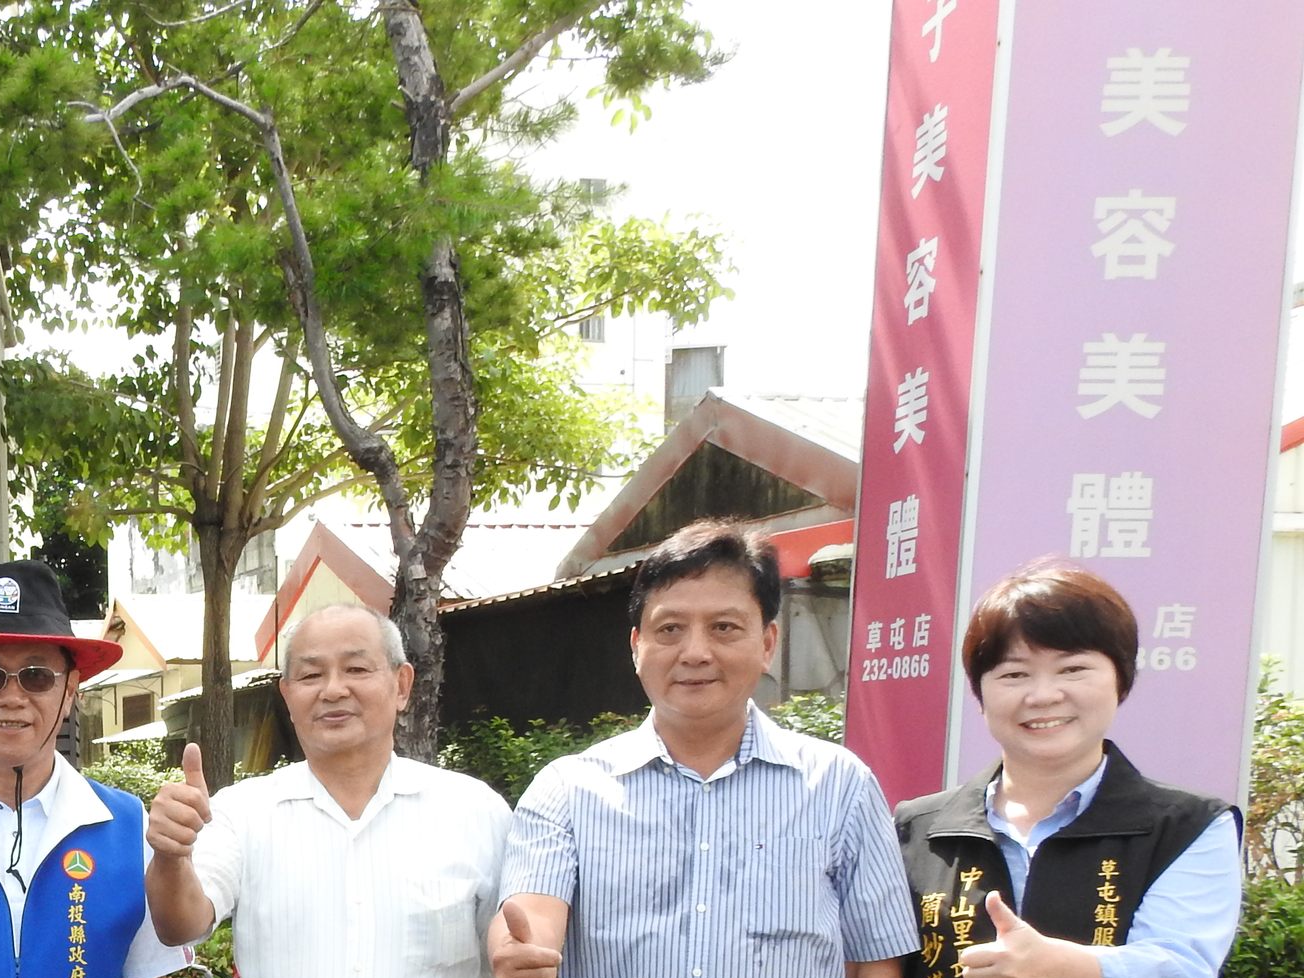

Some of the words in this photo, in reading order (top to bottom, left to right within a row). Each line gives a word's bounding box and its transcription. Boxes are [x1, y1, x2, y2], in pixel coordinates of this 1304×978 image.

[1067, 47, 1192, 558] 美容美體
[865, 613, 932, 653] 草屯店
[1152, 603, 1197, 638] 店
[861, 653, 930, 682] 232-0866
[1092, 859, 1120, 946] 草屯鎮服
